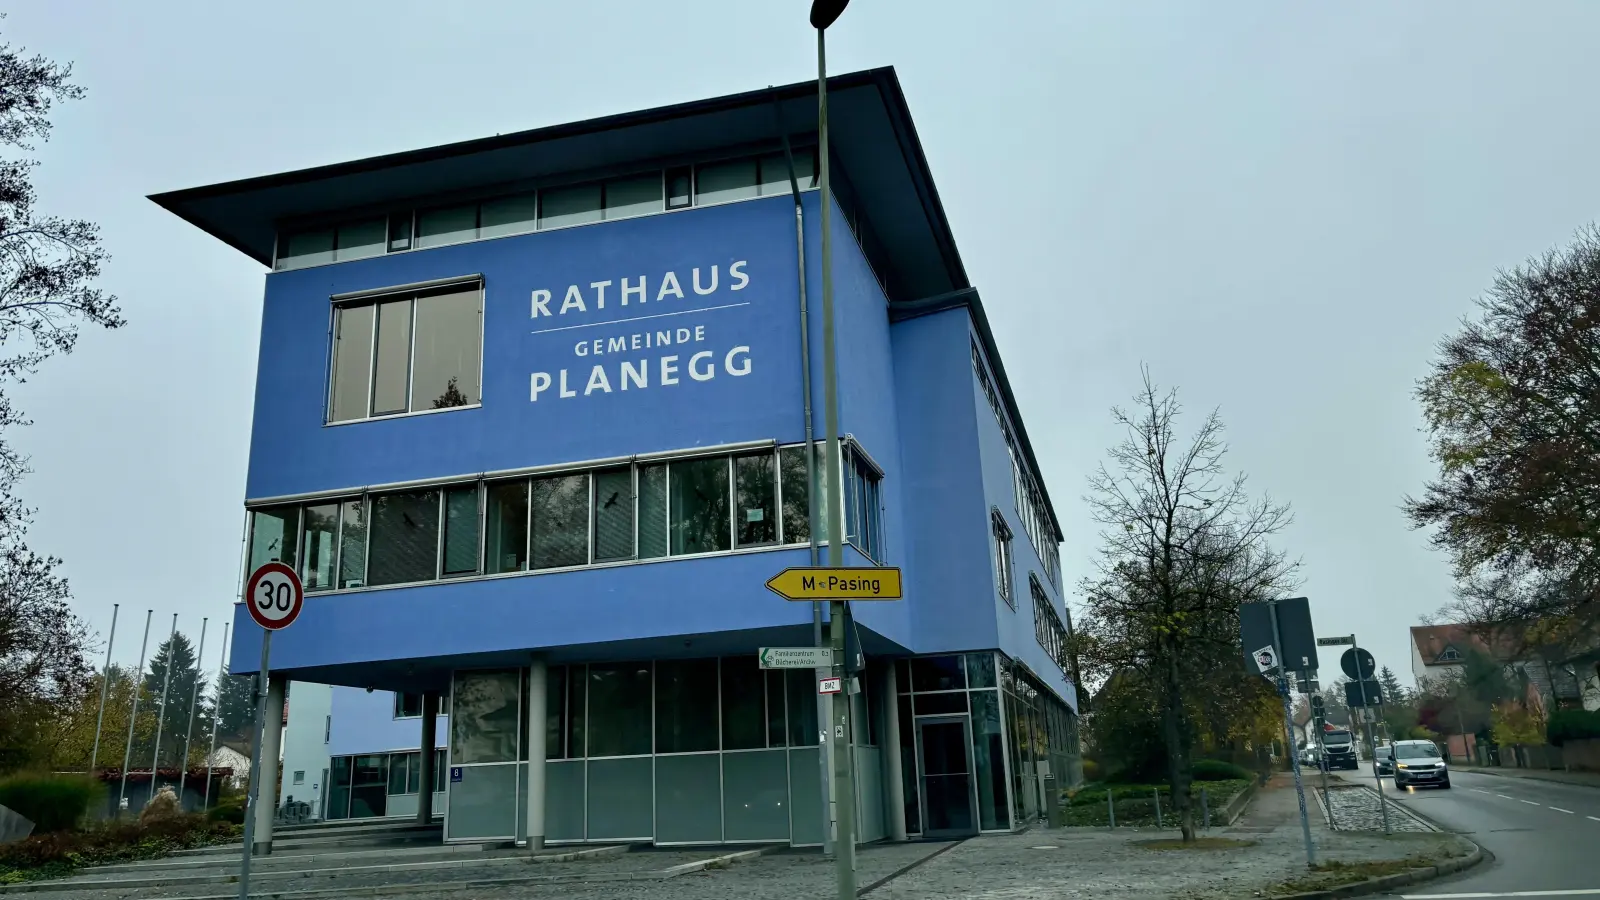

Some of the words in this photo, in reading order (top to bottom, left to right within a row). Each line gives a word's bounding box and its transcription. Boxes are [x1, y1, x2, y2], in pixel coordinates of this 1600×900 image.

[531, 260, 750, 318] RATHAUS
[574, 325, 705, 357] GEMEINDE
[530, 345, 752, 402] PLANEGG
[258, 580, 291, 611] 30
